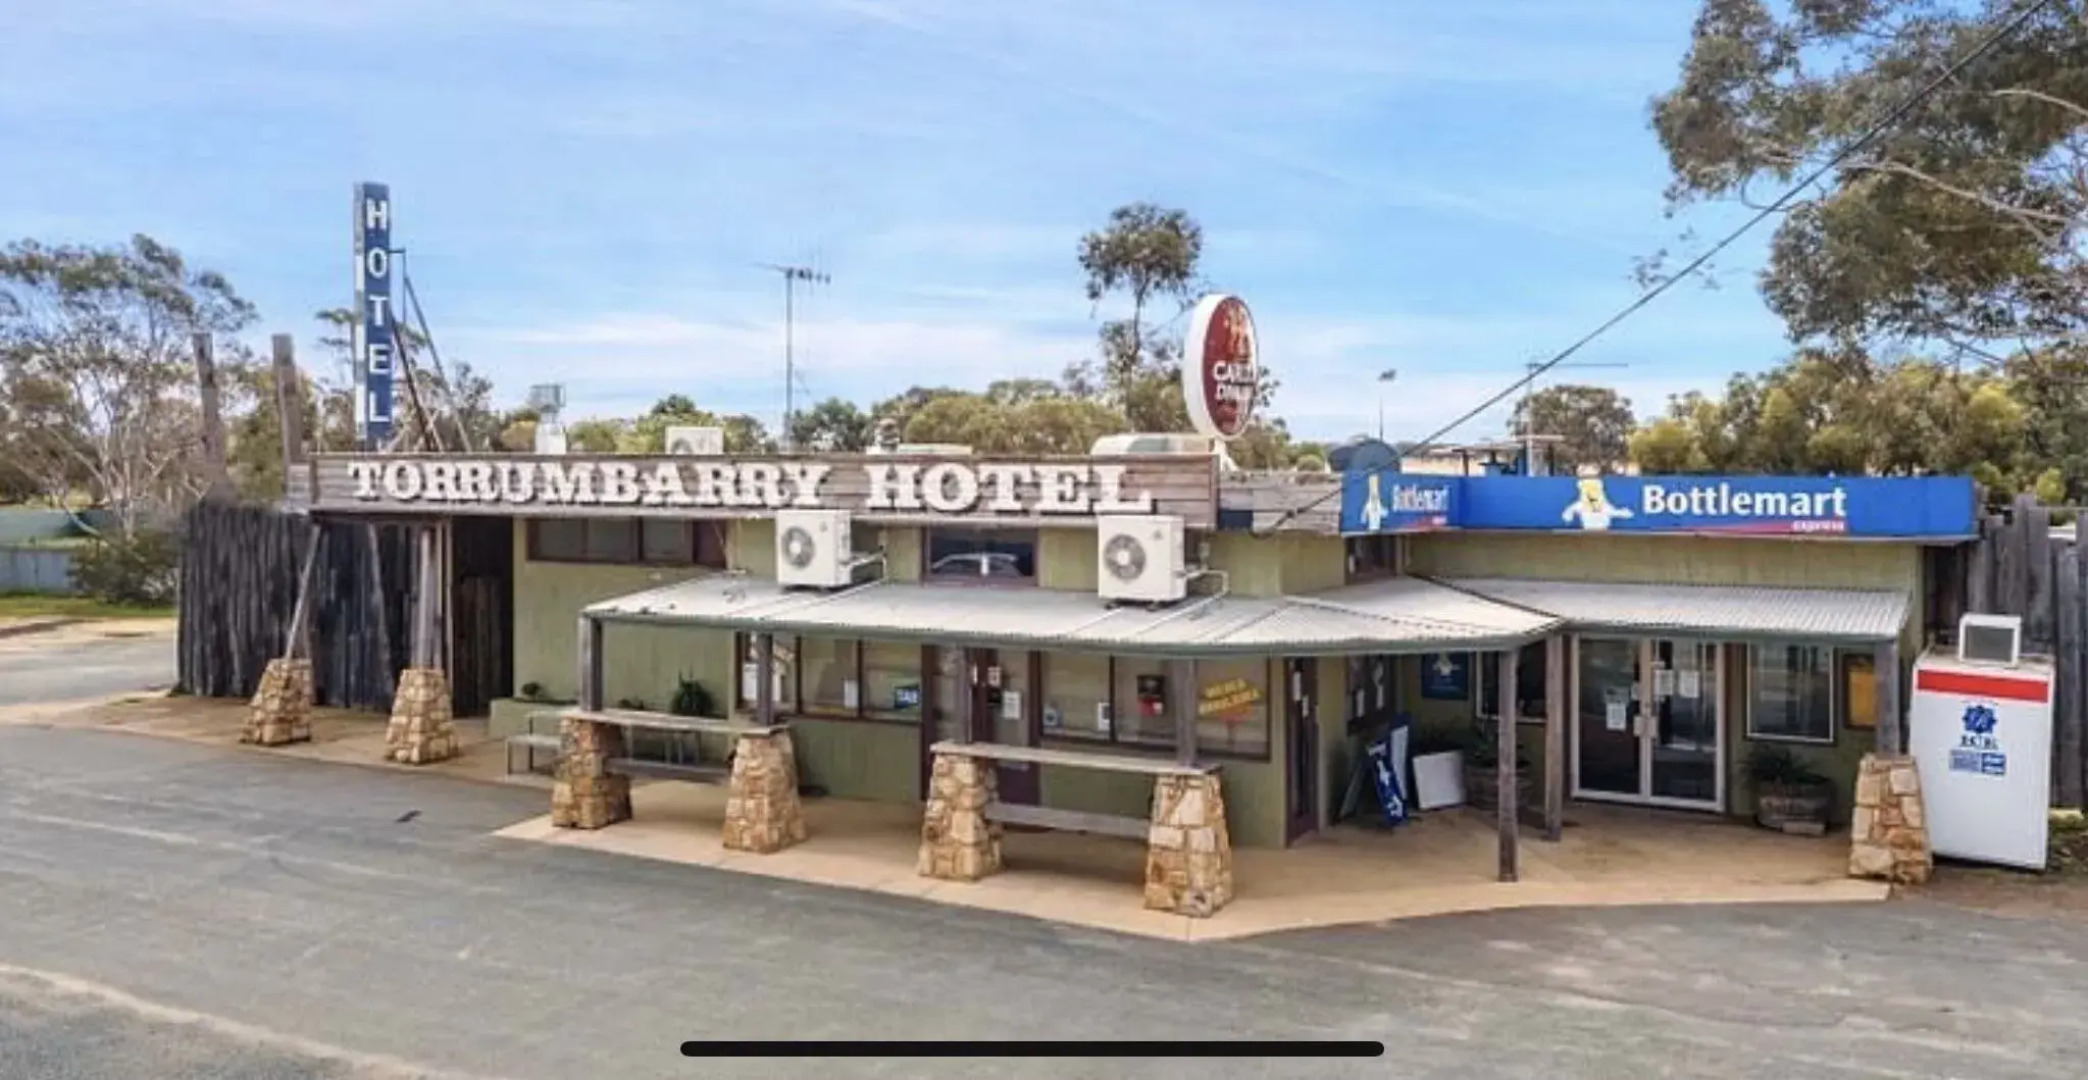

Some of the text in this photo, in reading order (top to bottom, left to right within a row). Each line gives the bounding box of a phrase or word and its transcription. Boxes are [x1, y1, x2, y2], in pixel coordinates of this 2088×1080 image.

[366, 197, 389, 422] HOTEL
[348, 460, 1152, 514] TORRUMBARRY HOTEL
[1642, 483, 1847, 517] Bottlemart
